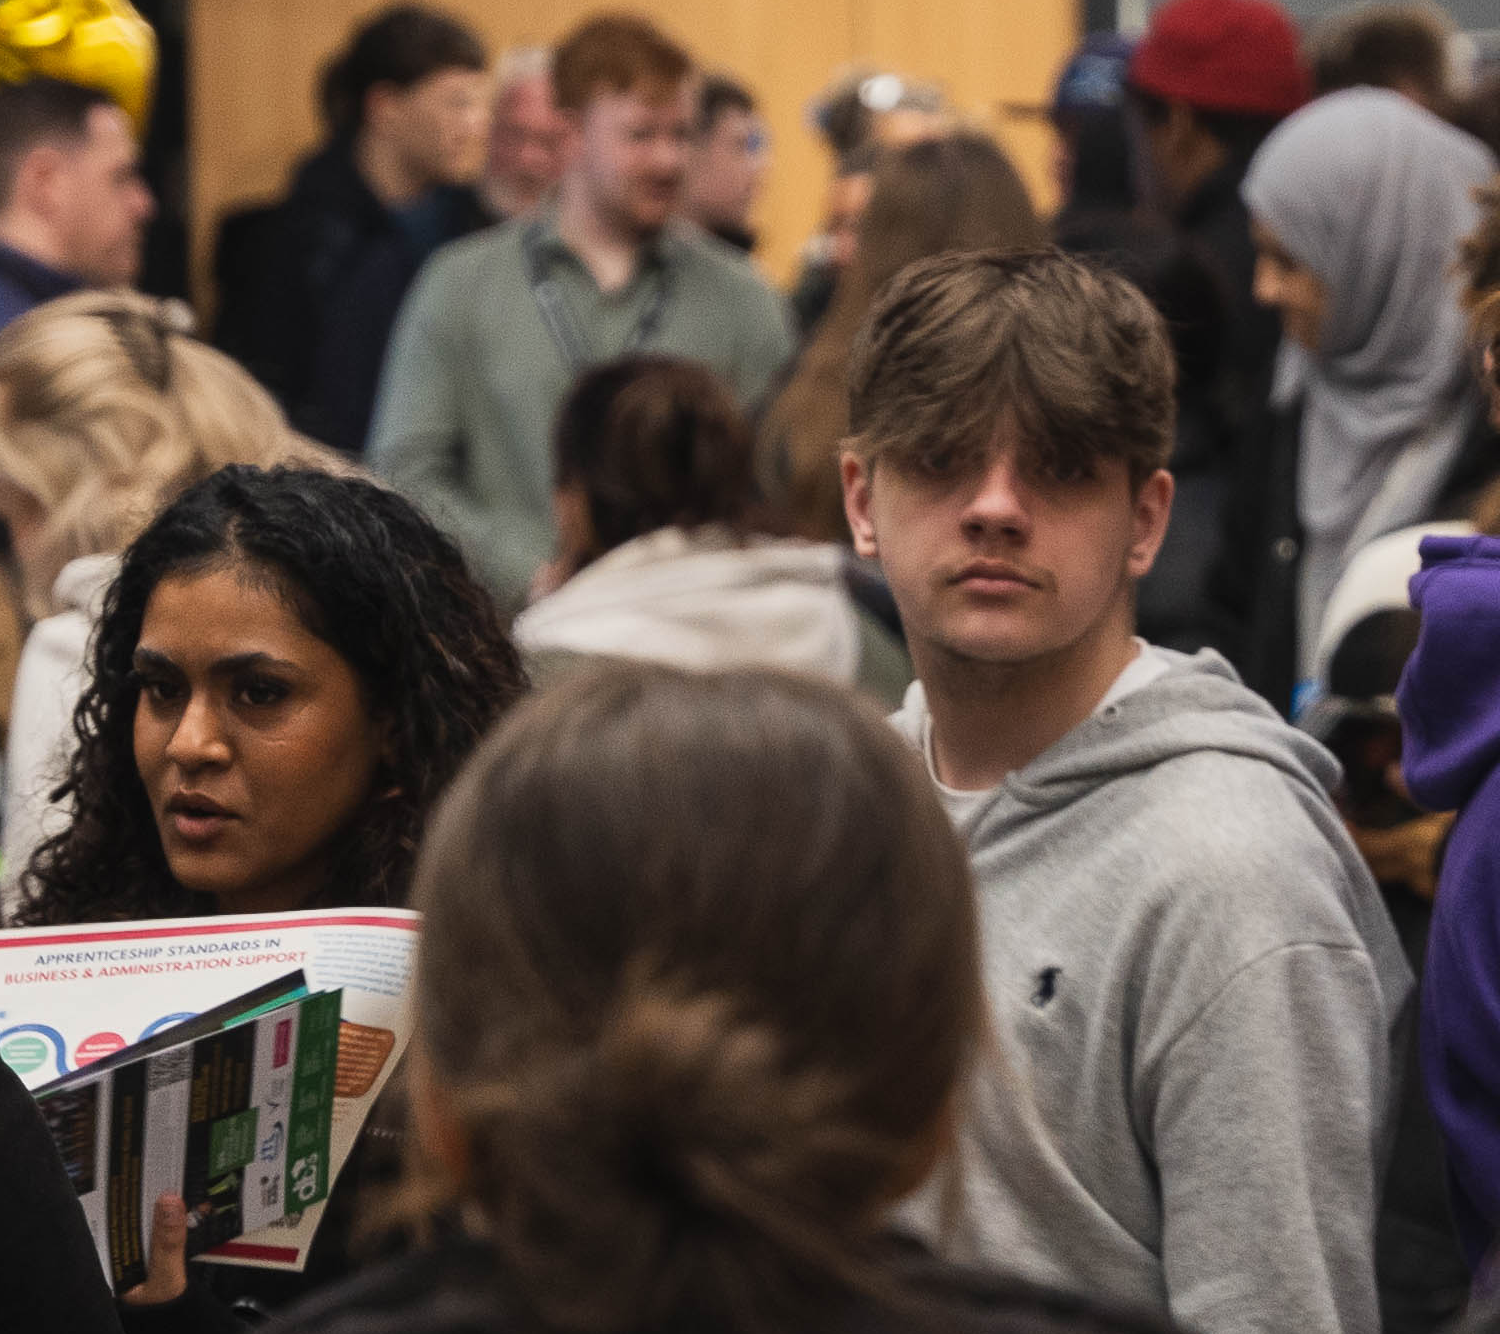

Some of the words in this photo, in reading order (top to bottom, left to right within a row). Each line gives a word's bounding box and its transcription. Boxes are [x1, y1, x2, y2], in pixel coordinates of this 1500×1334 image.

[34, 946, 163, 966] APPRENTICESHIP
[167, 939, 260, 958] STANDARDS
[265, 938, 281, 949] IN
[4, 969, 78, 985] BUSINESS
[82, 967, 94, 979] &
[99, 956, 231, 977] ADMINISTRATION
[235, 951, 308, 968] SUPPORT
